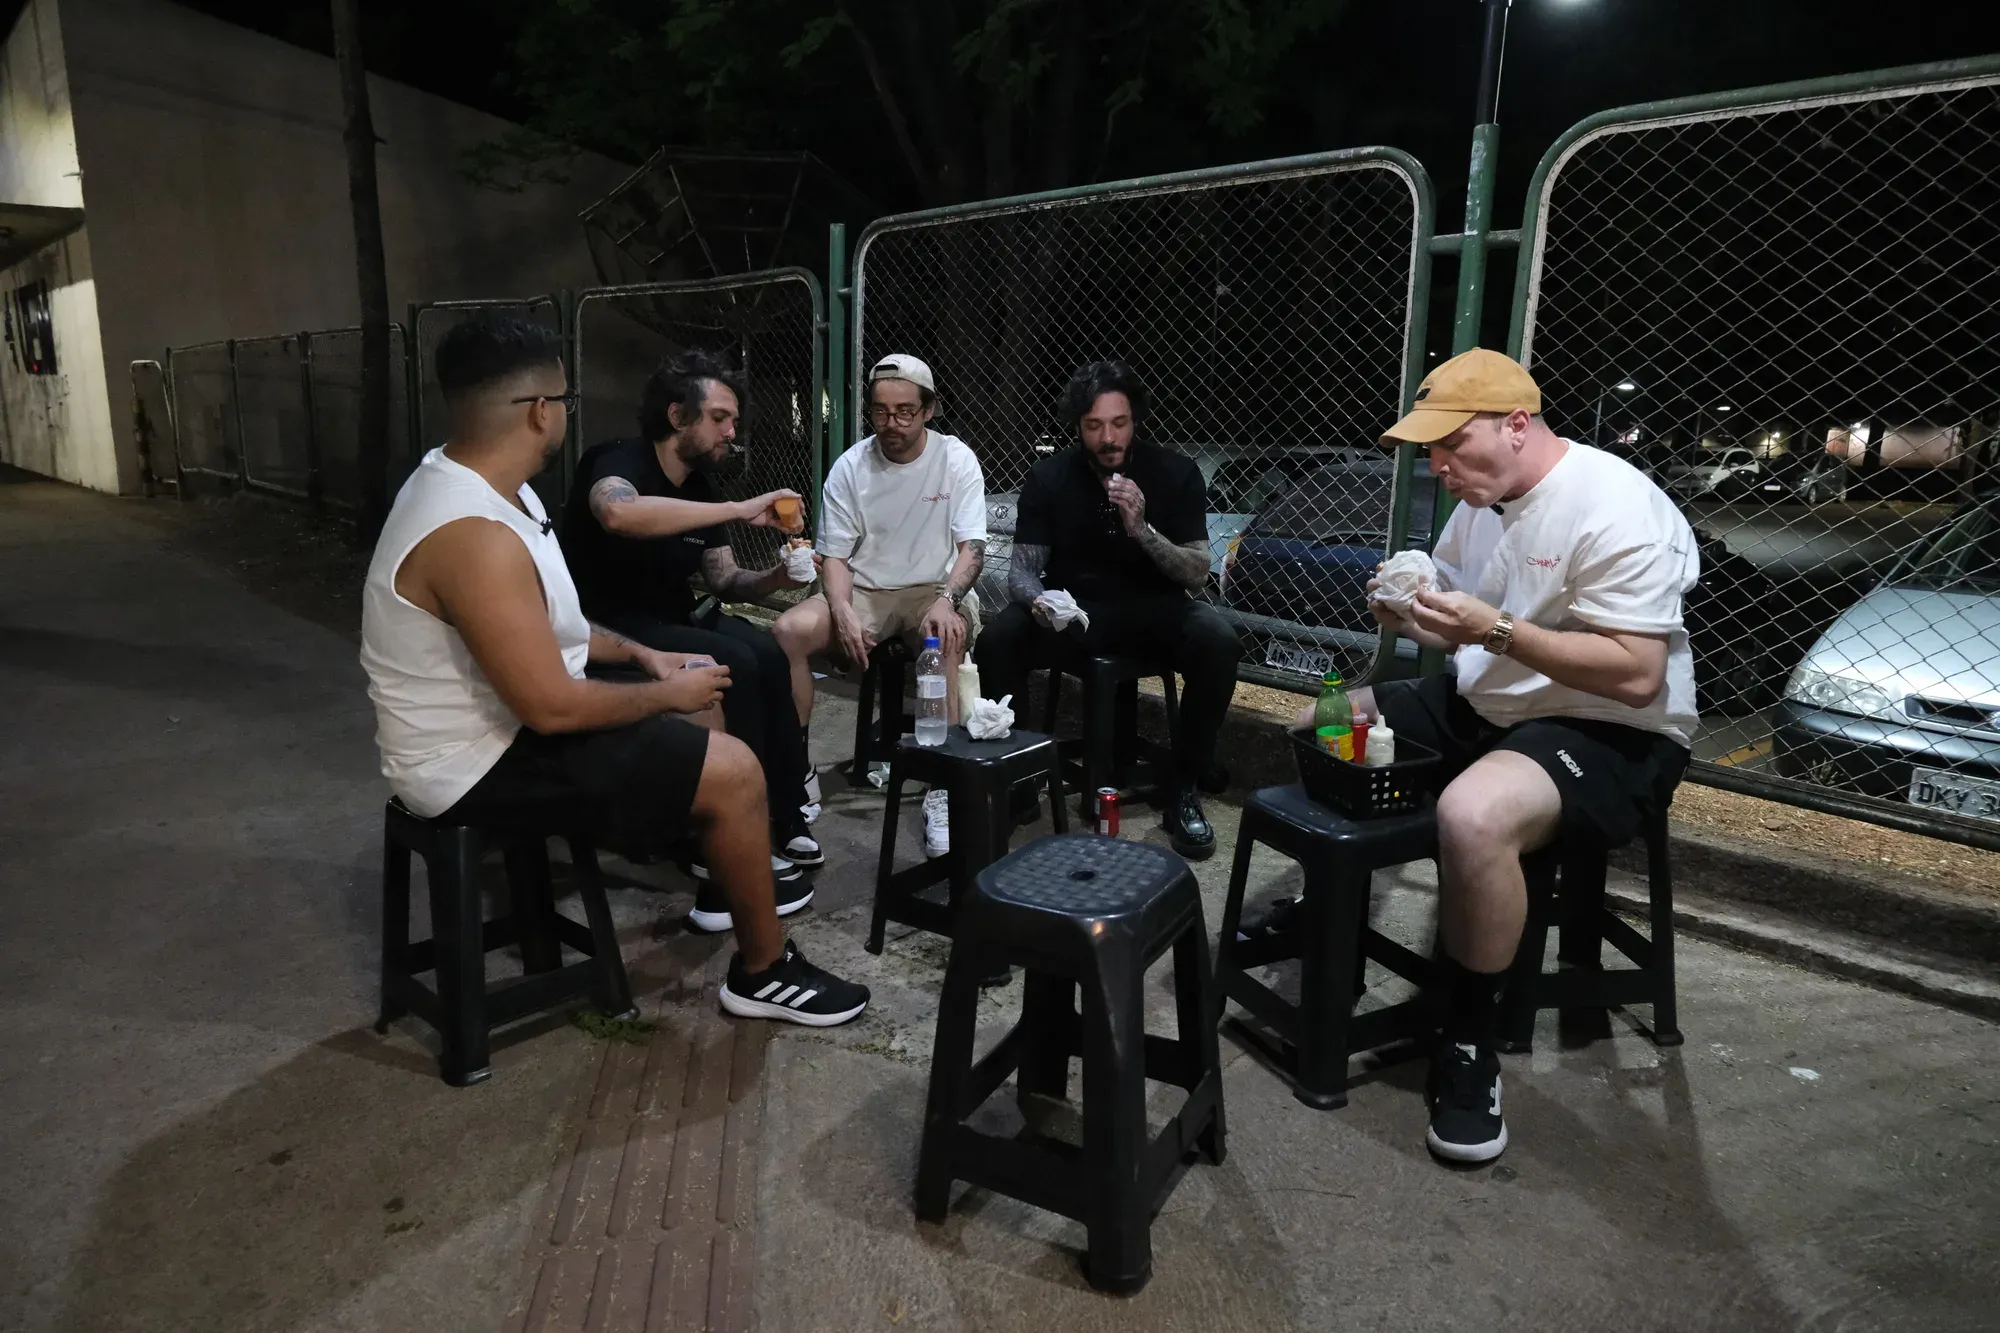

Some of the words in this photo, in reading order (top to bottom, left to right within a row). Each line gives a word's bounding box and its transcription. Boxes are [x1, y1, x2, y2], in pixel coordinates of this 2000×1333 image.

[1556, 749, 1584, 778] HIGH
[1917, 783, 1969, 810] DKY
[1979, 793, 2000, 813] 3
